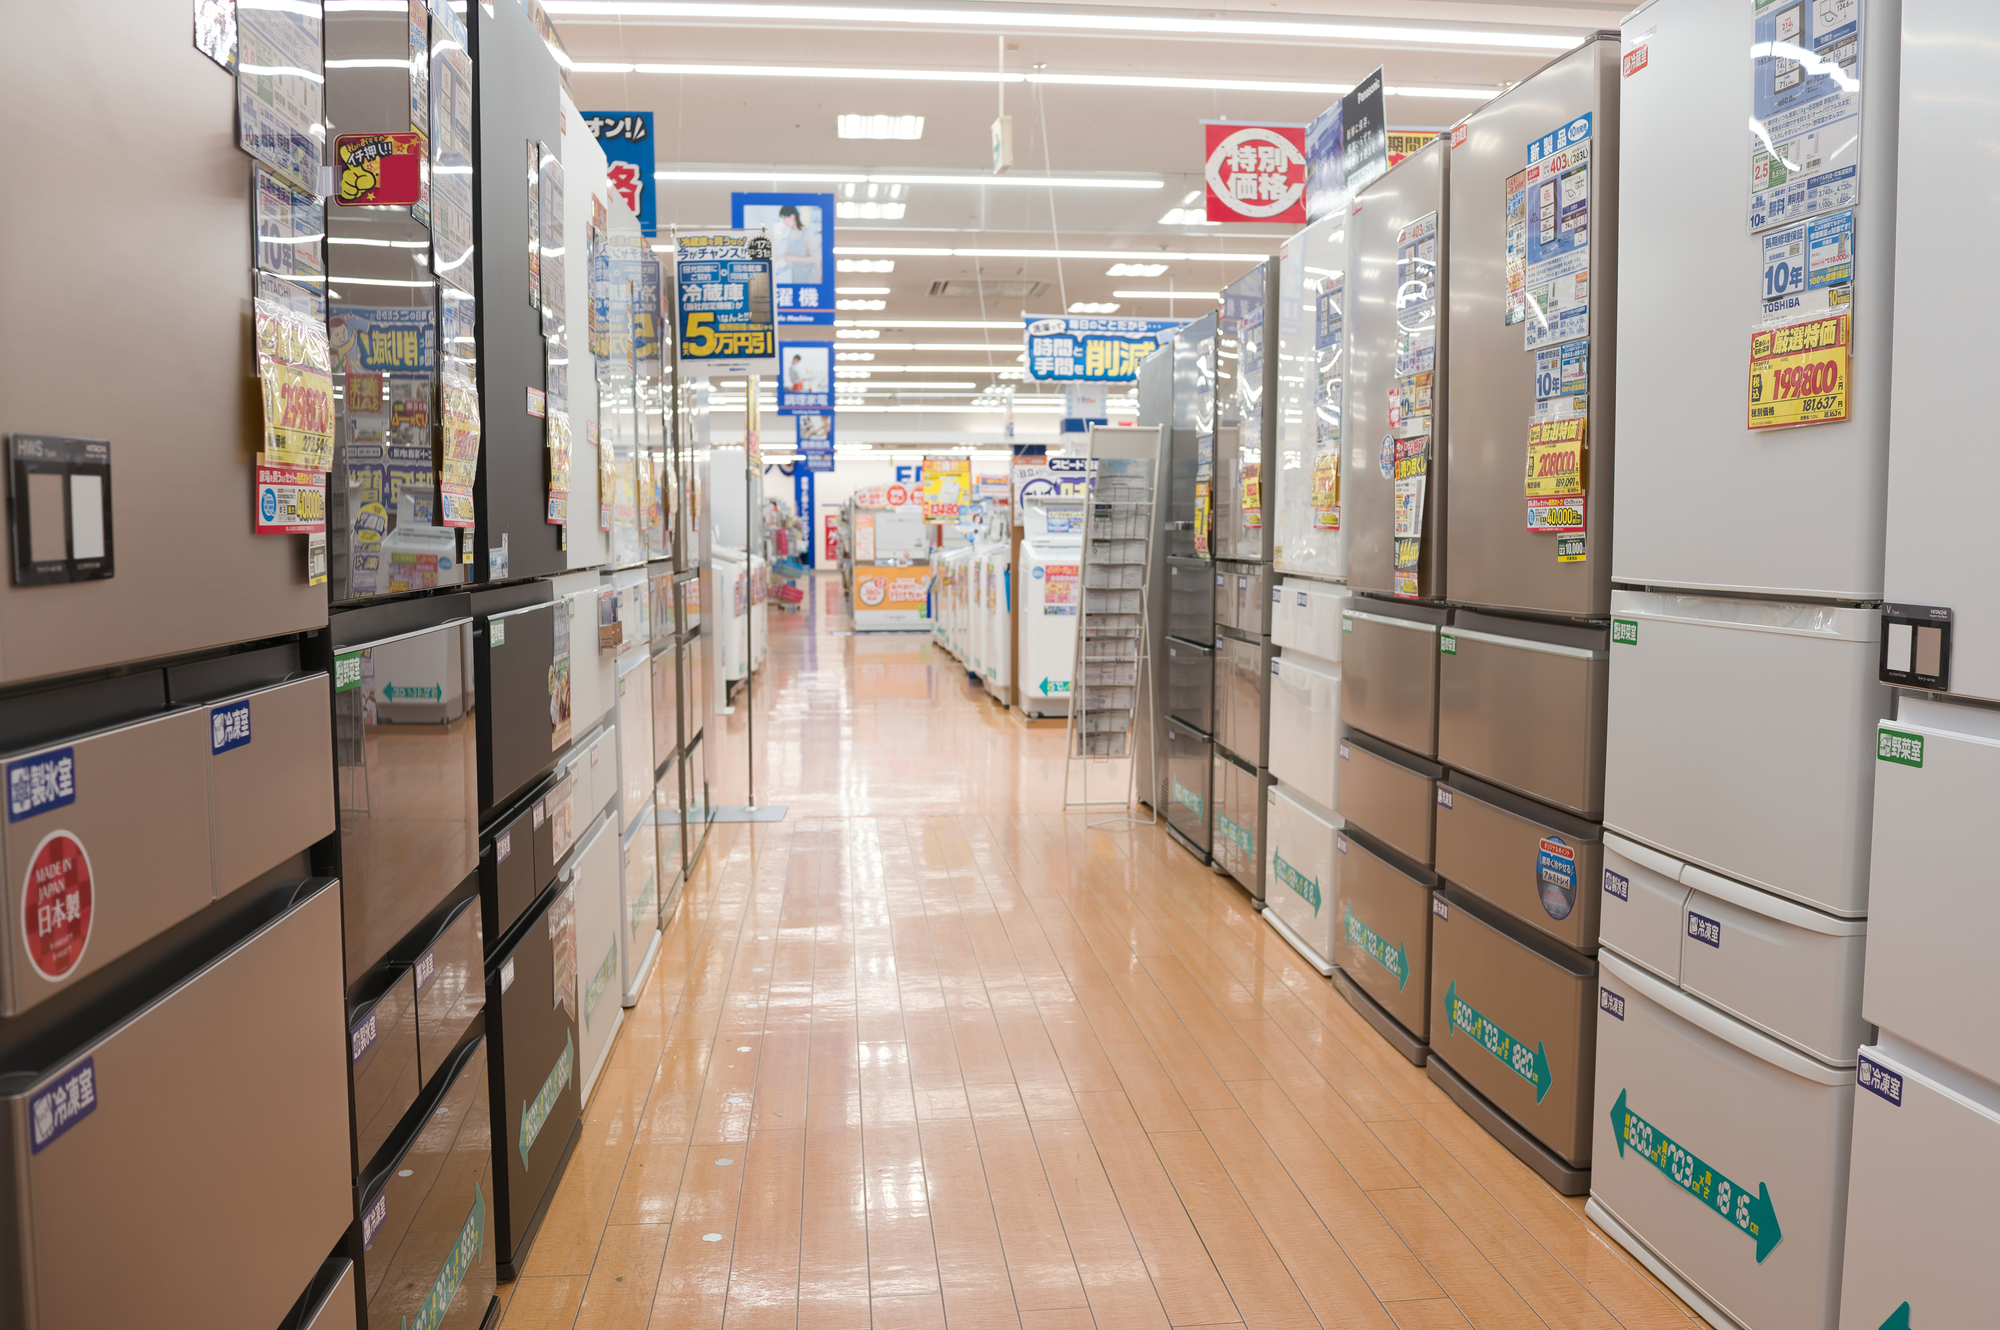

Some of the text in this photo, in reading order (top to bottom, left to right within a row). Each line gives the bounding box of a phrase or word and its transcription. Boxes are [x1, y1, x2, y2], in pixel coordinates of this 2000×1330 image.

[1357, 78, 1380, 104] Panasonic
[347, 135, 386, 152] 私のおすすめ
[1530, 128, 1566, 162] 新製品
[1227, 145, 1288, 174] 特別
[1755, 163, 1768, 180] 2.5
[1226, 172, 1289, 201] 価格
[261, 220, 292, 275] 10年
[680, 236, 744, 247] 冷蔵庫を買うなら
[260, 277, 292, 299] HITACHI
[1765, 262, 1802, 295] 10年
[682, 284, 744, 302] 冷蔵庫
[1763, 297, 1800, 313] TOSHIBA
[1033, 338, 1083, 357] 時間と
[1773, 319, 1838, 355] 厳選特価
[1034, 357, 1084, 376] 手間を
[1537, 372, 1560, 397] 10年
[1802, 396, 1837, 412] 181,637
[343, 656, 361, 684] 野菜室
[224, 707, 250, 743] 冷凍室
[1891, 736, 1922, 763] 野菜室
[30, 756, 74, 807] 製氷室
[36, 856, 73, 884] MADE IN
[1543, 870, 1570, 888] アルミトレイ
[37, 877, 66, 906] JAPAN
[1612, 873, 1628, 898] 製氷室
[37, 890, 82, 938] 日本製
[1697, 919, 1719, 944] 冷凍室
[1608, 995, 1624, 1017] 冷凍室
[360, 1015, 377, 1052] 製氷室
[1871, 1066, 1901, 1101] 冷凍室
[53, 1067, 94, 1128] 冷凍室
[370, 1195, 386, 1234] 冷凍室
